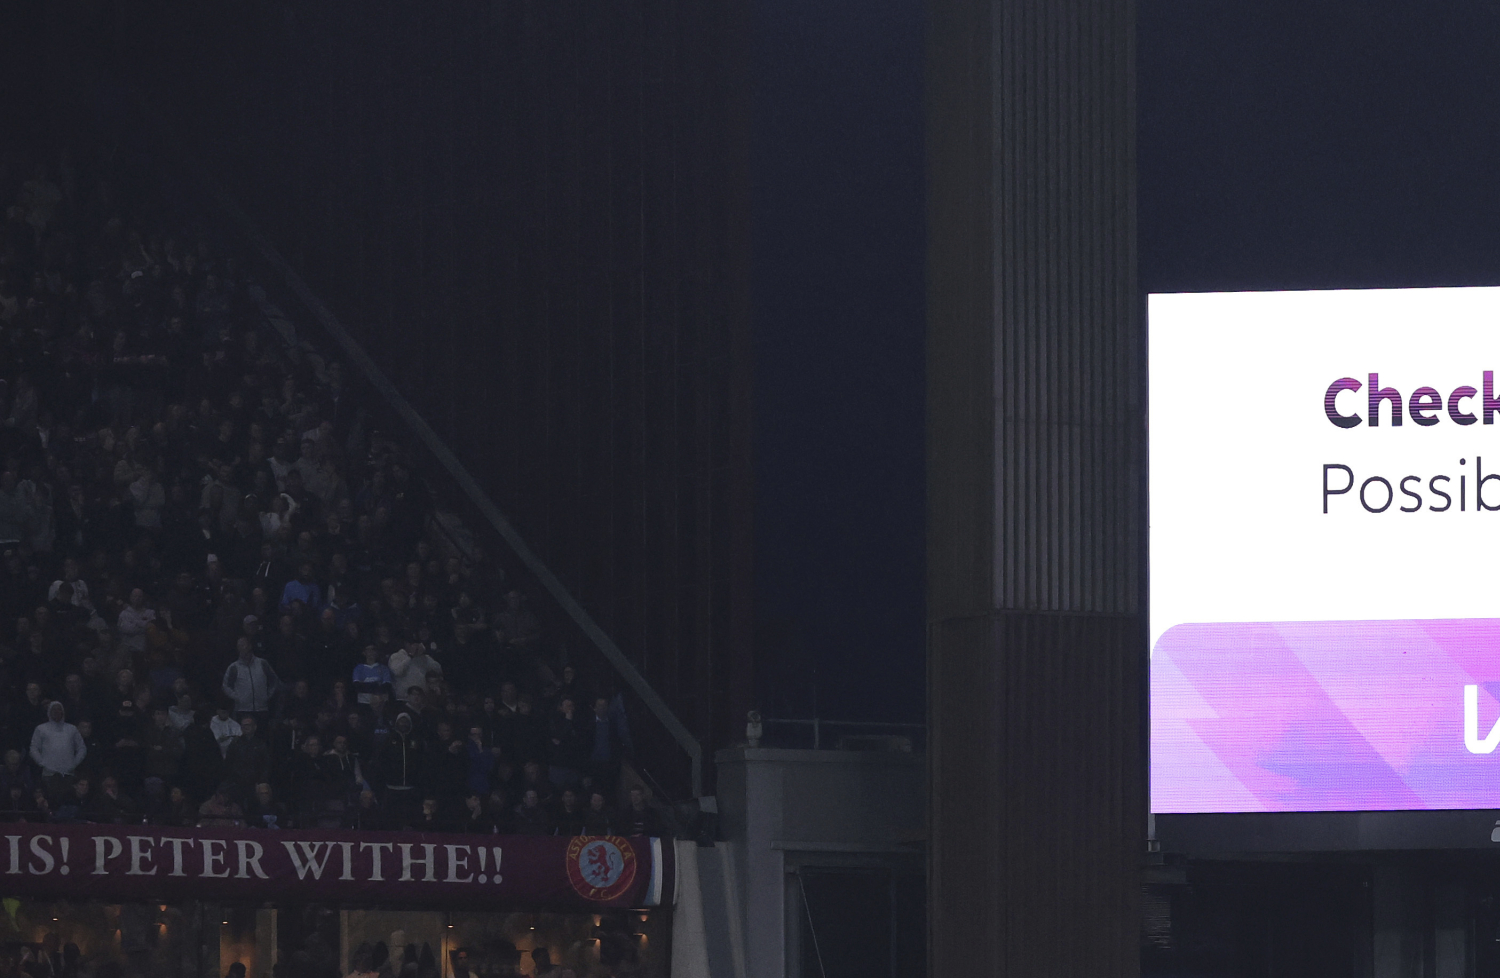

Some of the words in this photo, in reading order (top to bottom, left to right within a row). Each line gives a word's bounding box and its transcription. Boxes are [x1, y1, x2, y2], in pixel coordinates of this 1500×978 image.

[4, 834, 71, 876] IS!
[90, 836, 269, 879] PETER
[280, 840, 503, 885] WITHE!!
